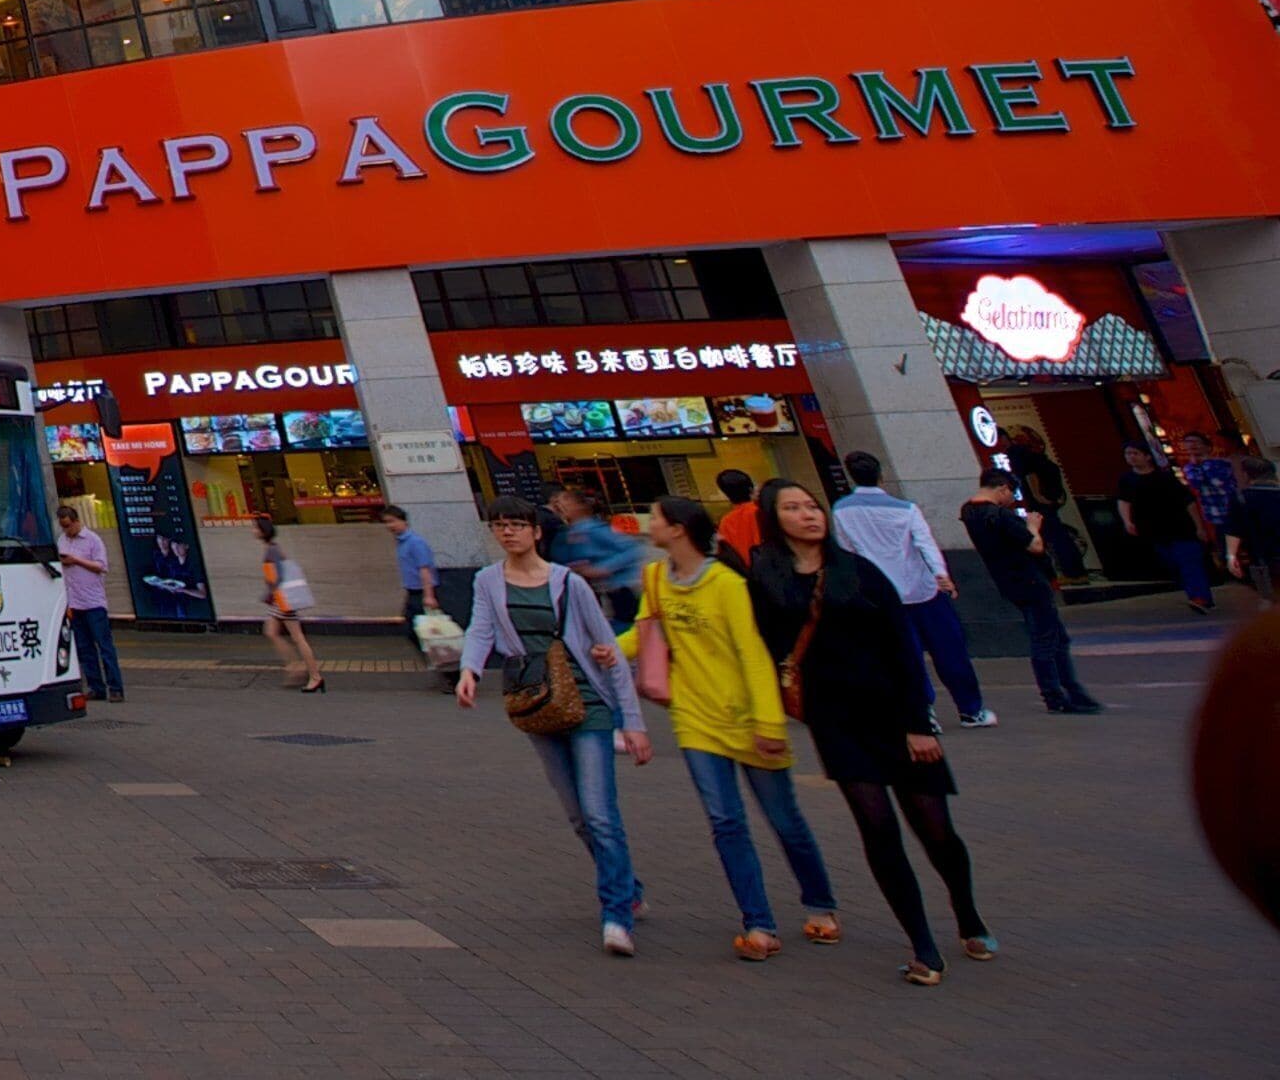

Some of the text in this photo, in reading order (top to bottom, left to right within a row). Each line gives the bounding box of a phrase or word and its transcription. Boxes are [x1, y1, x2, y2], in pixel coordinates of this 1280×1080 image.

[457, 343, 799, 379] 帕帕珍味 马来西亚白咖啡餐厅
[18, 618, 42, 660] 察
